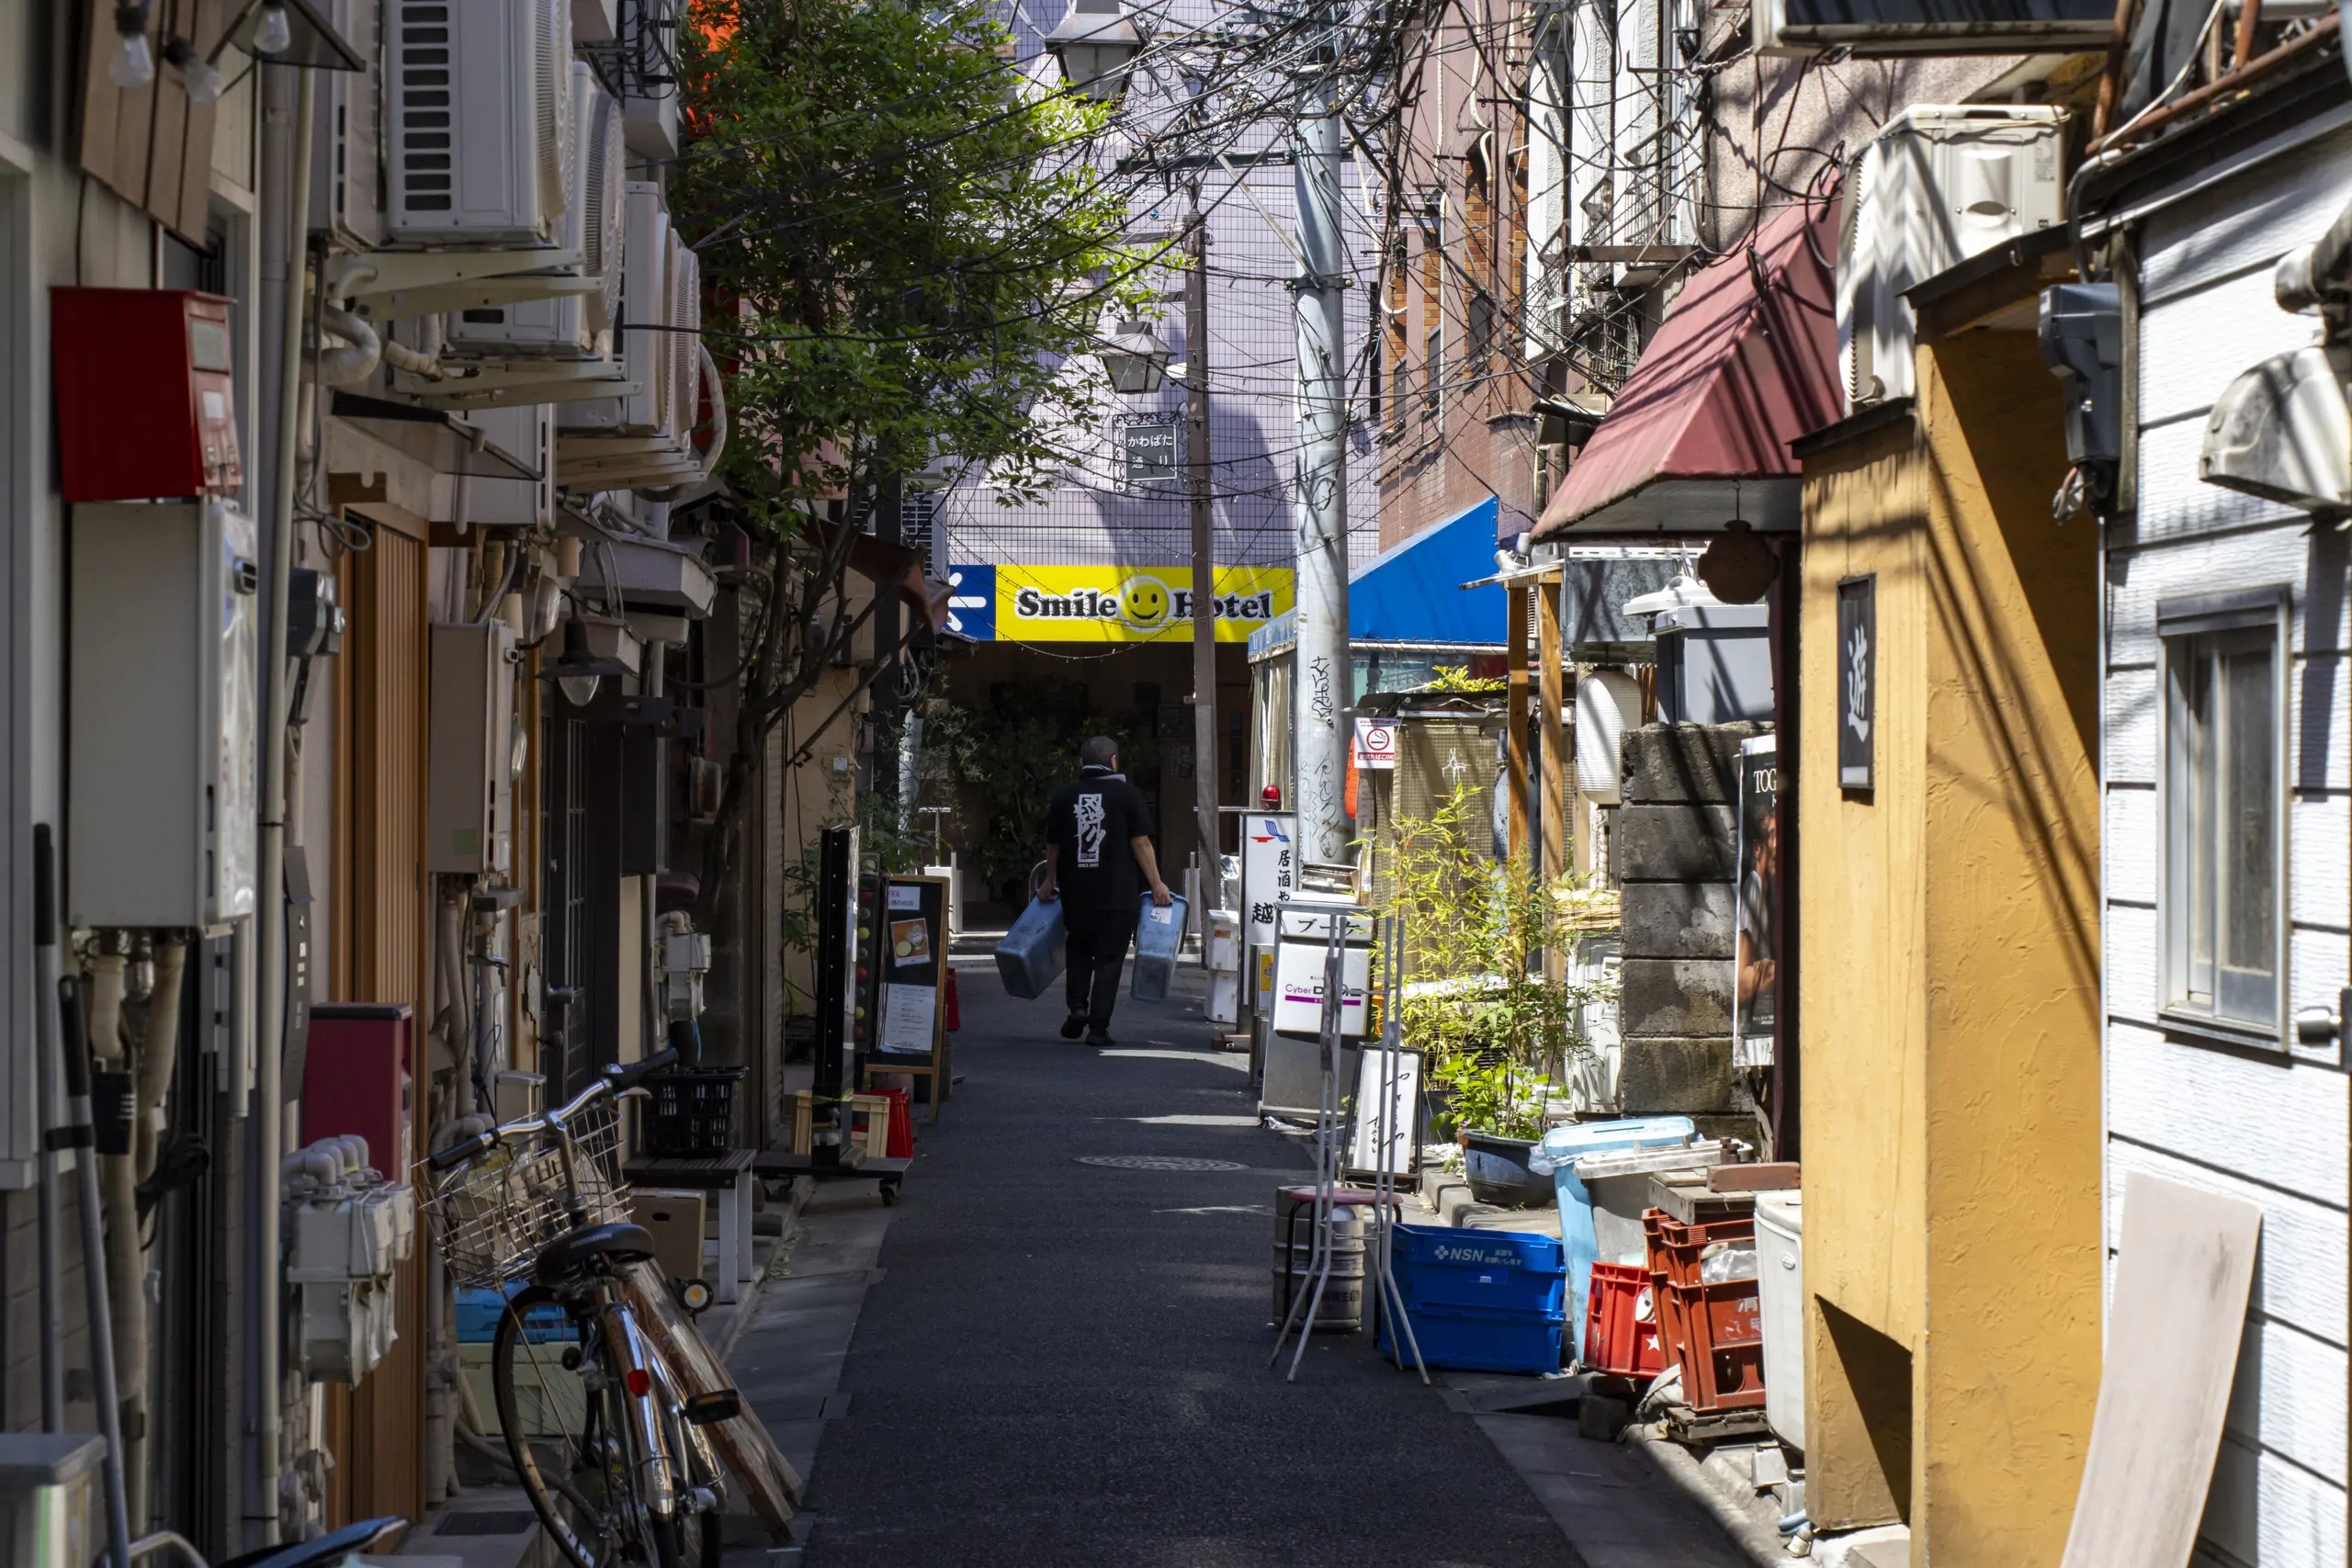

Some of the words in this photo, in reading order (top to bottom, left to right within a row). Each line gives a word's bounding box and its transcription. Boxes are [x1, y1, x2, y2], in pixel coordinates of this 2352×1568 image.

[1128, 434, 1172, 447] かわばた
[1018, 591, 1117, 616] Smile
[1278, 849, 1292, 901] 居酒や
[1285, 984, 1311, 994] Cyber
[1450, 1248, 1484, 1261] NSN
